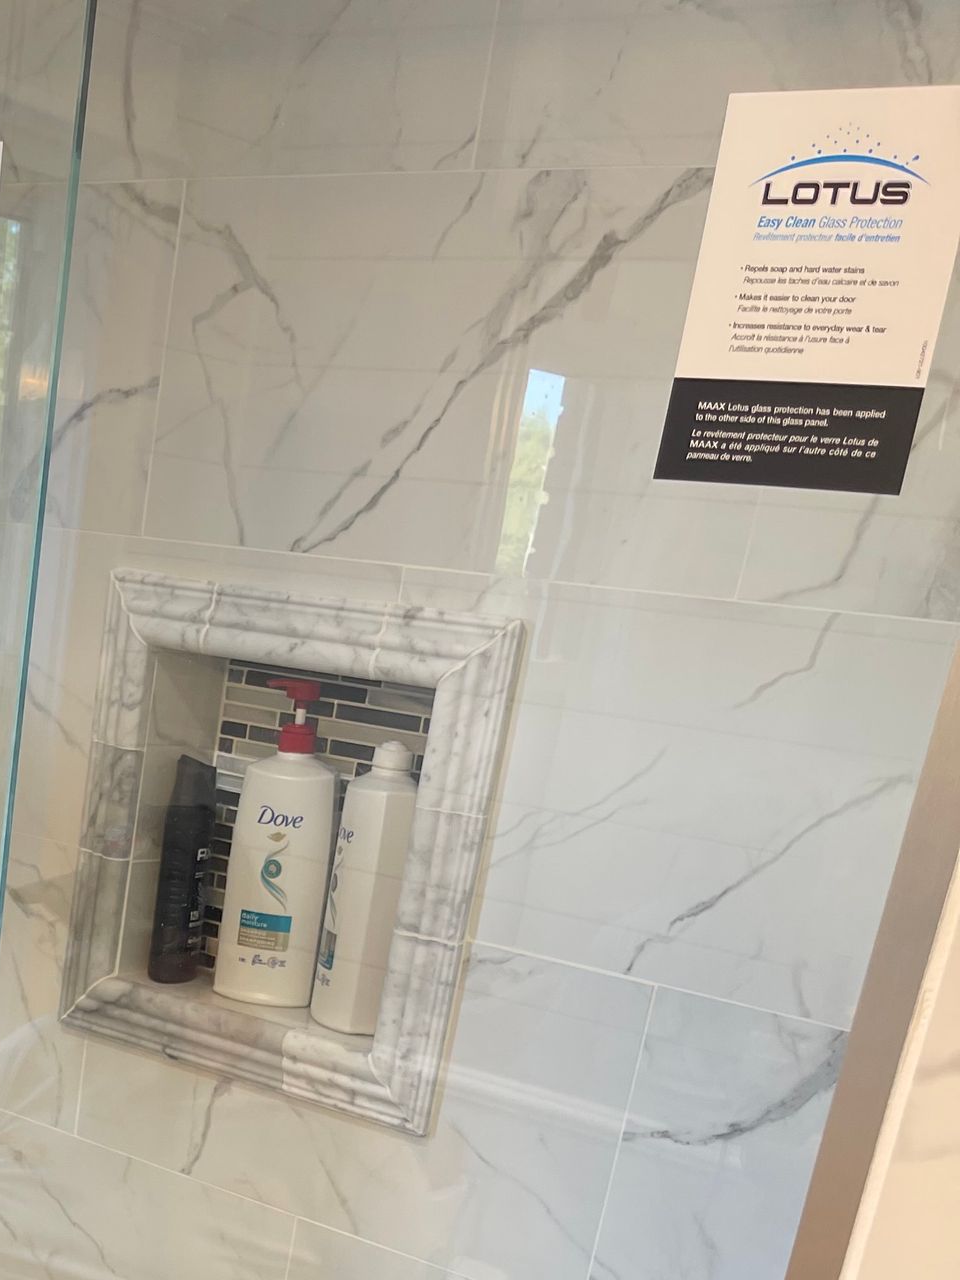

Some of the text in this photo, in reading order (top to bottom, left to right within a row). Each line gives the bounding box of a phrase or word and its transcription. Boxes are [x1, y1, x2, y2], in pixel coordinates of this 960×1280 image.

[761, 181, 912, 206] LOTUS
[757, 216, 903, 230] Easy Clean Glass Protection
[744, 265, 768, 274] Repels
[770, 266, 787, 274] soap
[821, 266, 842, 274] water
[843, 266, 865, 274] stains
[769, 294, 790, 302] easier
[732, 322, 765, 330] Increases
[766, 323, 802, 331] resistance
[812, 324, 844, 333] everyday
[865, 325, 870, 333] &
[698, 401, 886, 419] MAAX Lotus glass protection has been applied
[696, 413, 829, 428] to the other side of this glass panel.
[691, 429, 701, 438] Le
[746, 431, 788, 442] protecteur
[789, 434, 808, 443] pour
[810, 434, 818, 443] le
[820, 436, 841, 444] verre
[842, 437, 866, 446] Lotus
[867, 438, 879, 447] de
[689, 439, 718, 449] MAAX
[729, 441, 742, 450] été
[744, 442, 780, 453] appliqué
[782, 445, 796, 453] sur
[798, 444, 826, 455] l'autre
[828, 446, 848, 456] côté
[850, 448, 863, 457] de
[864, 450, 876, 458] ce
[686, 451, 752, 462] panneau de verre.
[257, 805, 304, 829] Dove
